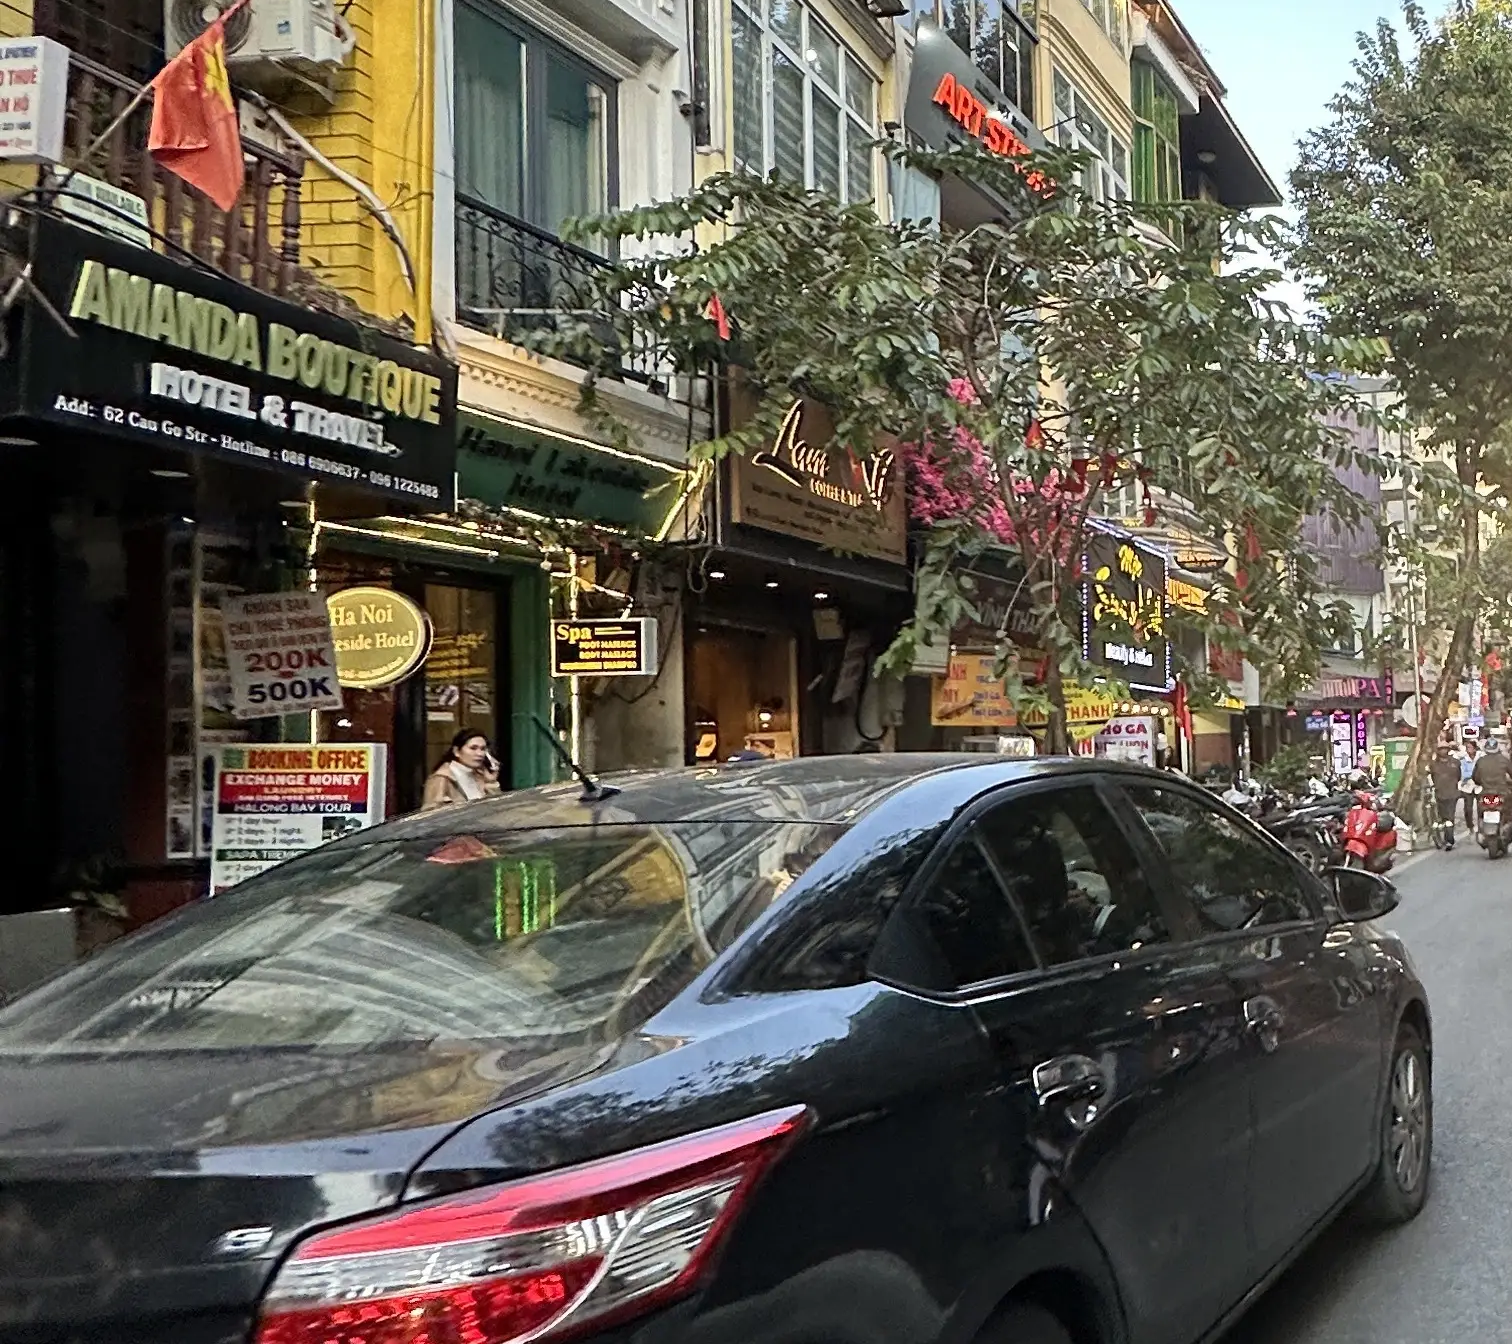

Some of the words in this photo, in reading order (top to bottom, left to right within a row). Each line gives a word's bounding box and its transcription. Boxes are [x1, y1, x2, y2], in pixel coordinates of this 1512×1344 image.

[932, 72, 988, 138] ART
[69, 259, 263, 373] AMANDA
[266, 322, 442, 425] BOUTIQUE
[150, 362, 257, 420] HOTEL
[261, 395, 289, 429] &
[291, 401, 402, 457] TRAVEL
[103, 405, 125, 424] 62
[162, 419, 182, 437] Go
[186, 425, 208, 444] Str
[330, 605, 357, 627] Ha
[360, 604, 393, 625] Noi
[375, 630, 414, 649] Hotel
[556, 624, 592, 645] Spa
[246, 647, 330, 672] 200K
[248, 675, 333, 704] 500K
[317, 748, 367, 770] OFFICE
[225, 774, 307, 786] EXCHANGE
[309, 774, 363, 786] MONEY
[234, 802, 289, 813] HALONG
[290, 802, 317, 813] BAY
[318, 802, 352, 812] TOUR
